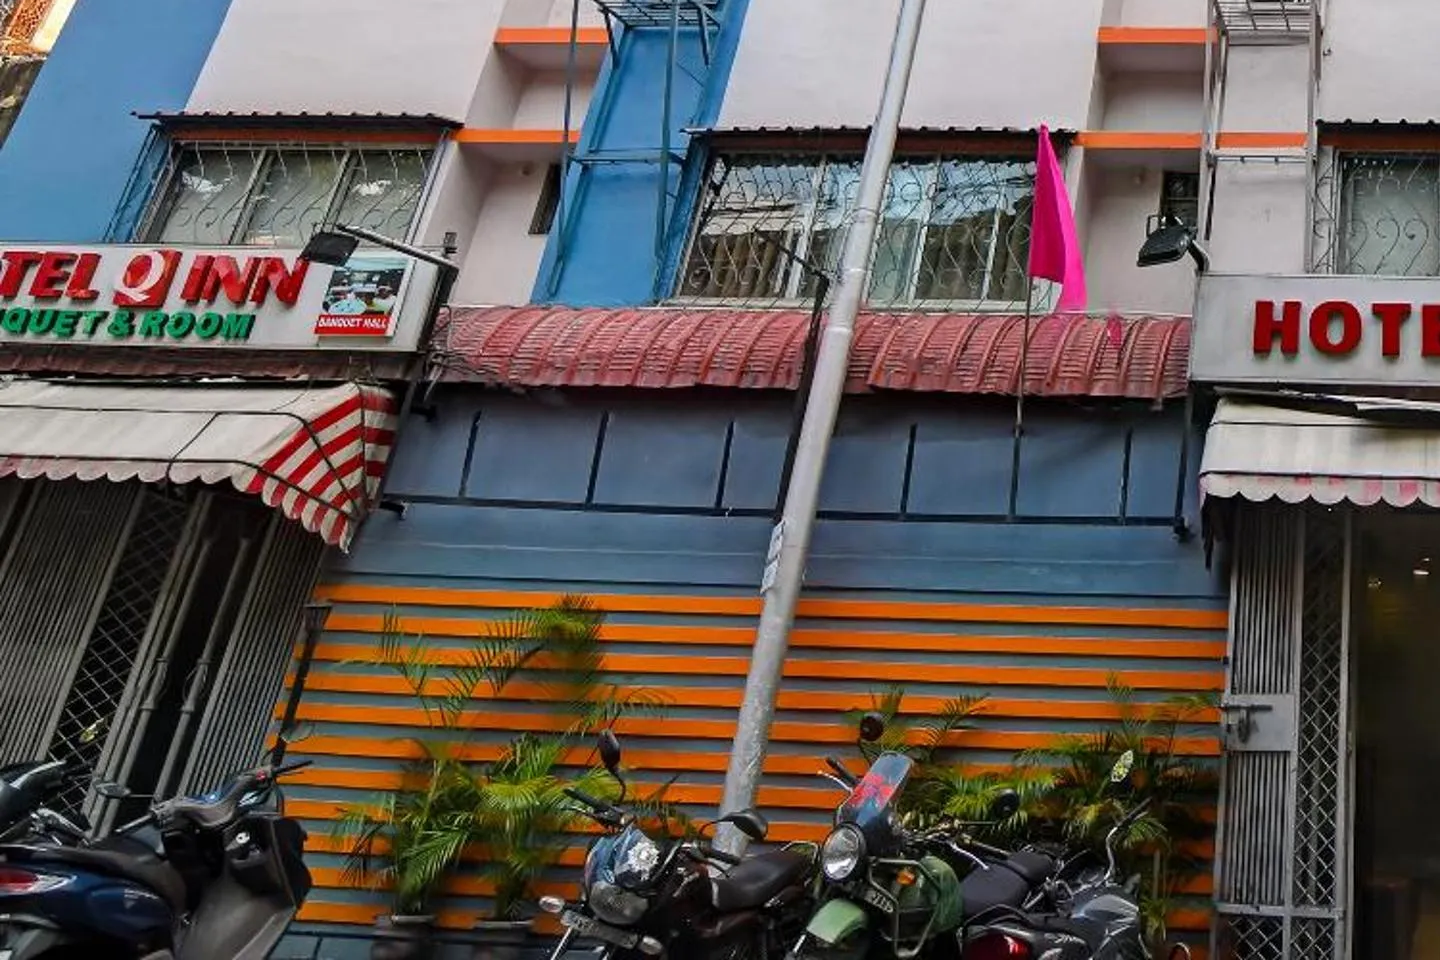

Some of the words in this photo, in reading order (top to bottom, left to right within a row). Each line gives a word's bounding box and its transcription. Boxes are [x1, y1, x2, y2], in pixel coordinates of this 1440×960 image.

[0, 251, 102, 299] TEL
[112, 249, 168, 304] Q
[180, 254, 311, 307] INN
[0, 309, 108, 337] QUET
[107, 309, 135, 337] &
[139, 311, 256, 341] ROOM
[318, 316, 363, 328] BANQUET
